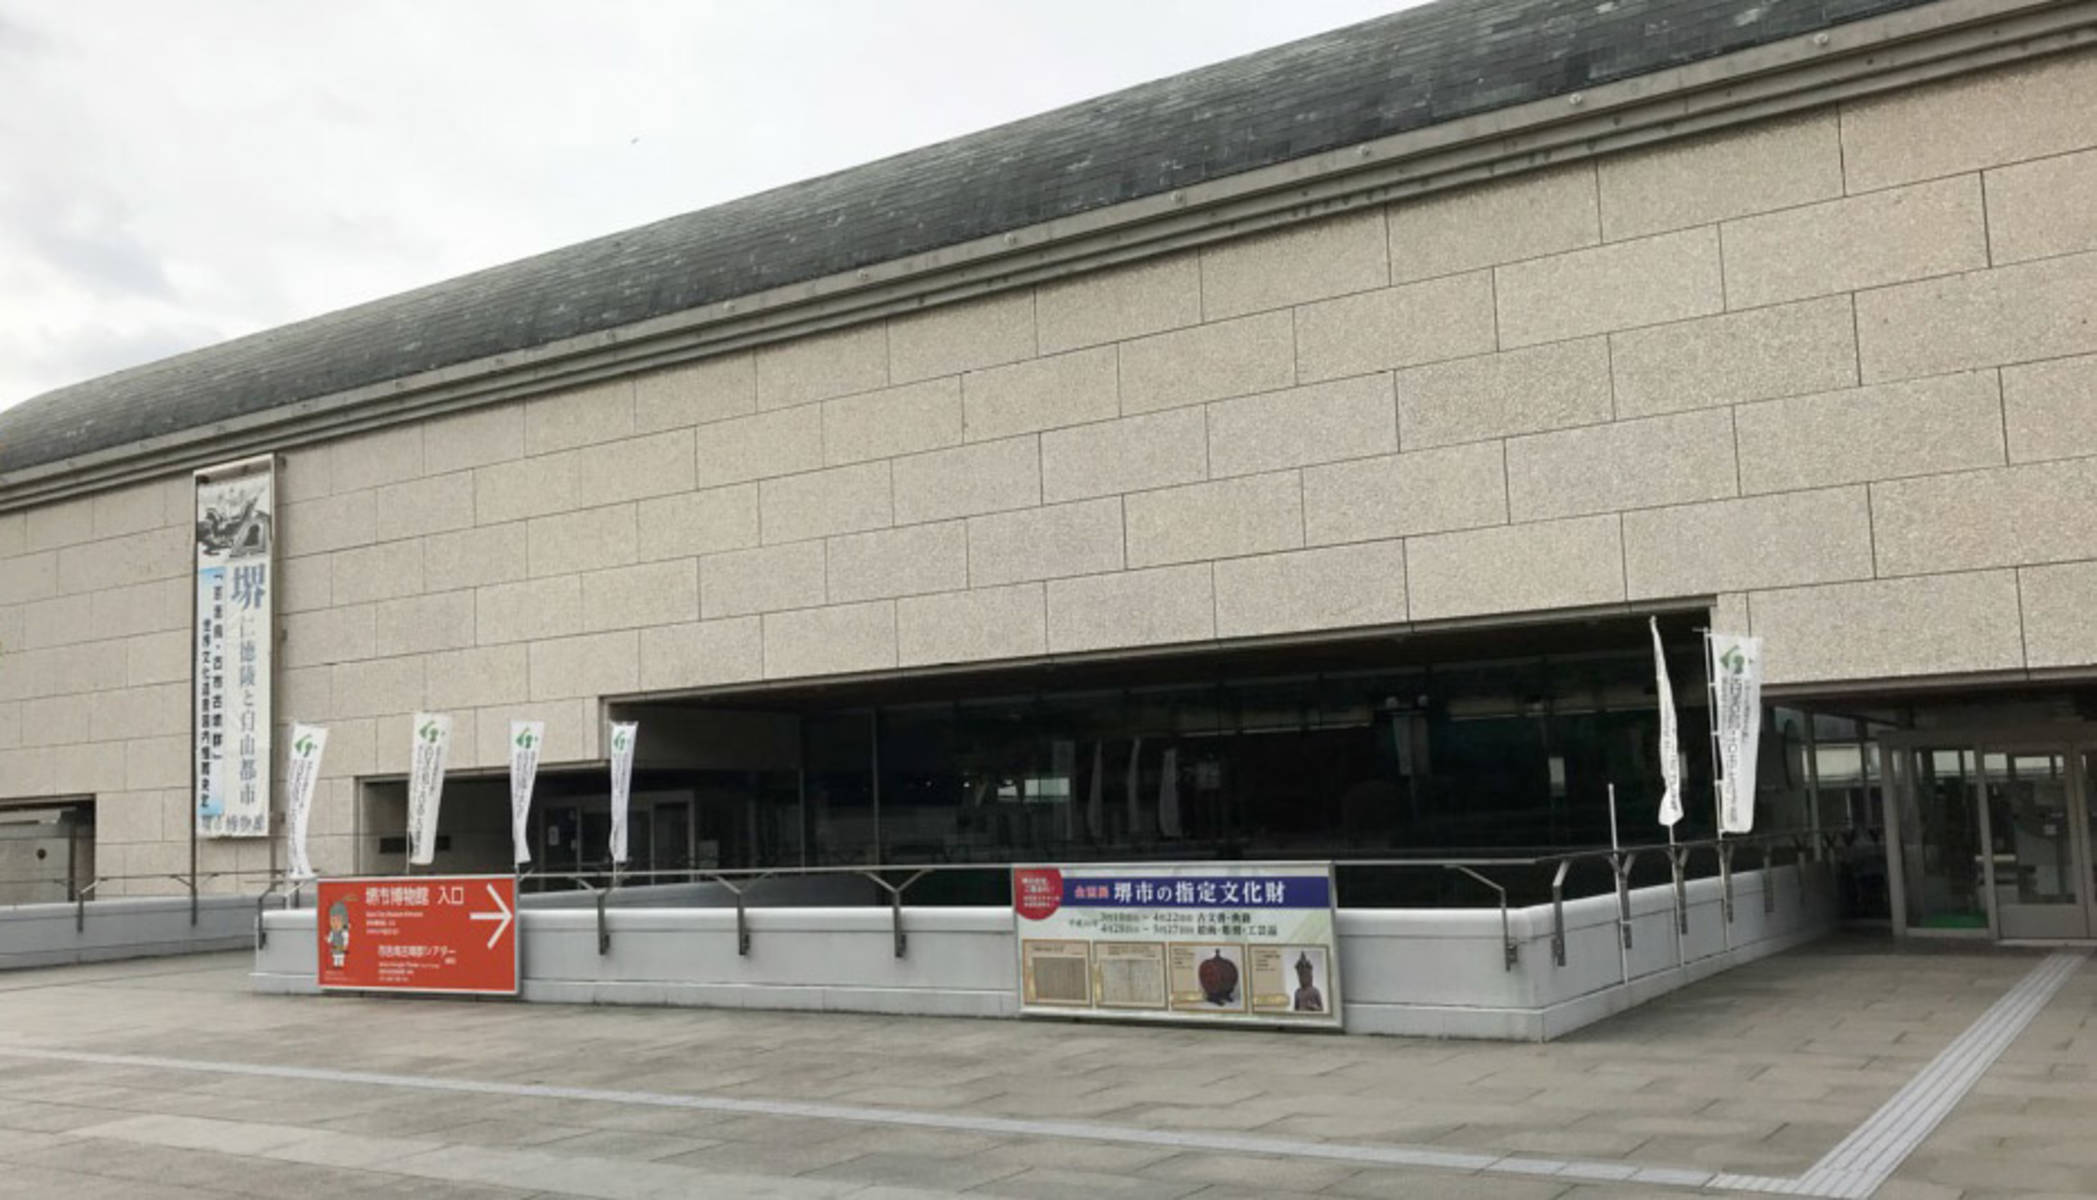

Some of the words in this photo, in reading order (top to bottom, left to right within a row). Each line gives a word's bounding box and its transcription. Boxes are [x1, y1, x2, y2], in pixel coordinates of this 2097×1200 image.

[231, 563, 266, 612] 堺
[437, 886, 465, 905] 入口
[1113, 881, 1286, 904] 堺市の指定文化財
